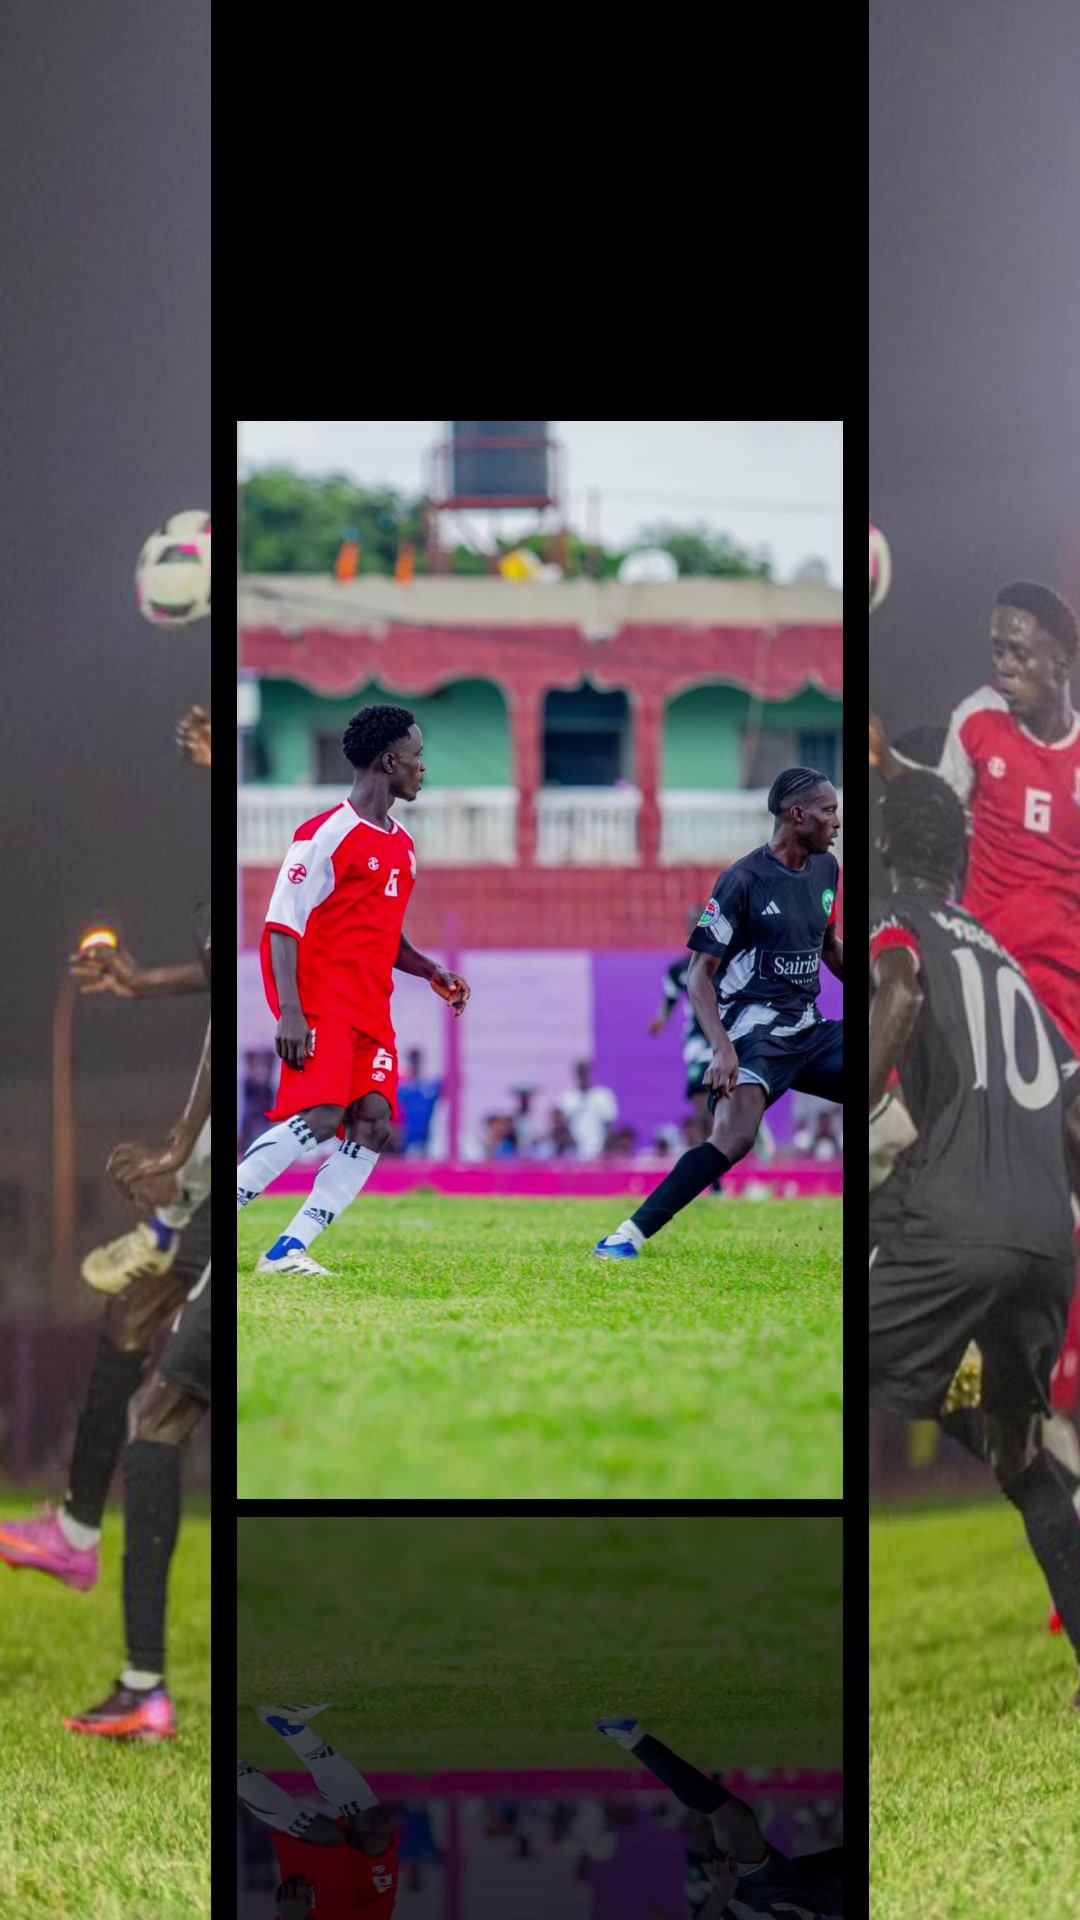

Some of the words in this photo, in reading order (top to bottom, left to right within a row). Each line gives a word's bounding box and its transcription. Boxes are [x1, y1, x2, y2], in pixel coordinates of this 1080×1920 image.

[1024, 787, 1052, 833] 6
[384, 868, 400, 897] 6
[952, 947, 1060, 1110] 10
[372, 1048, 394, 1071] 6
[303, 1209, 327, 1229] adida
